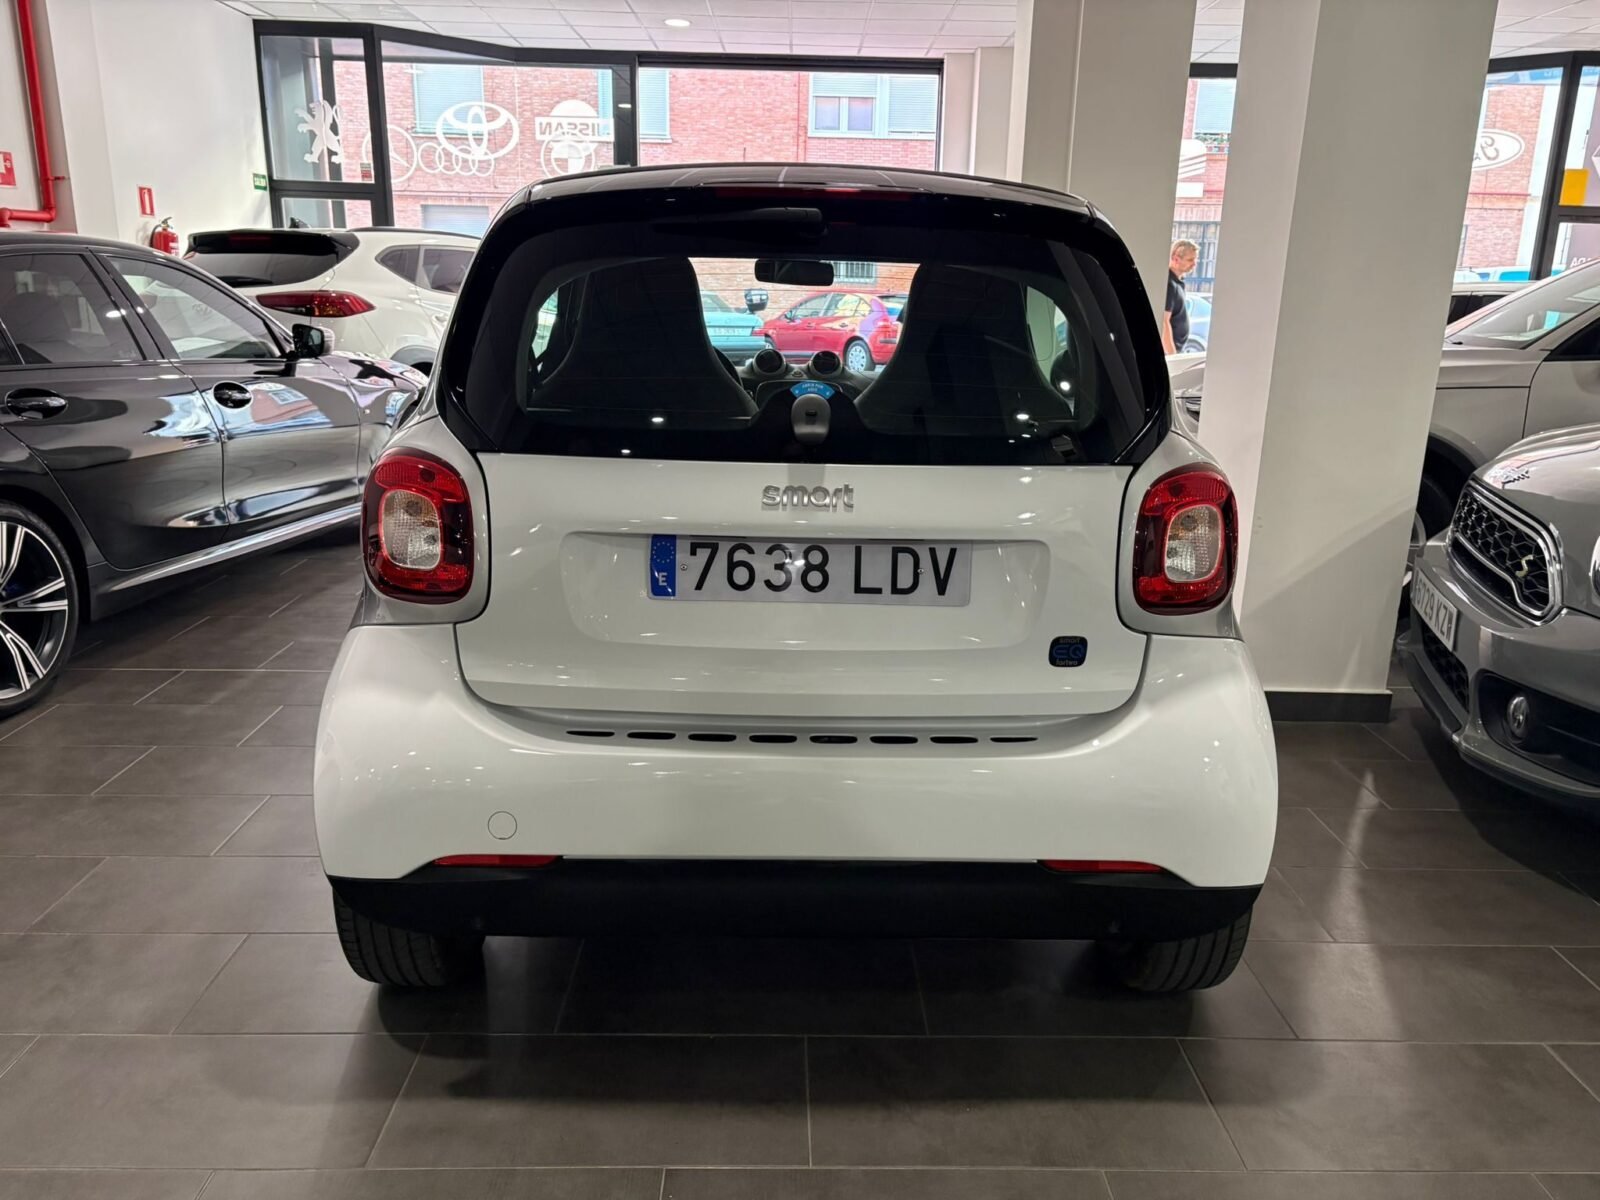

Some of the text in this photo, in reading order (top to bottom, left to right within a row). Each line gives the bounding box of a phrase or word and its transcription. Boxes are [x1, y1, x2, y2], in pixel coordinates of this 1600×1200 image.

[762, 484, 855, 509] smart
[658, 572, 668, 587] E
[689, 542, 958, 597] 7638 LDV
